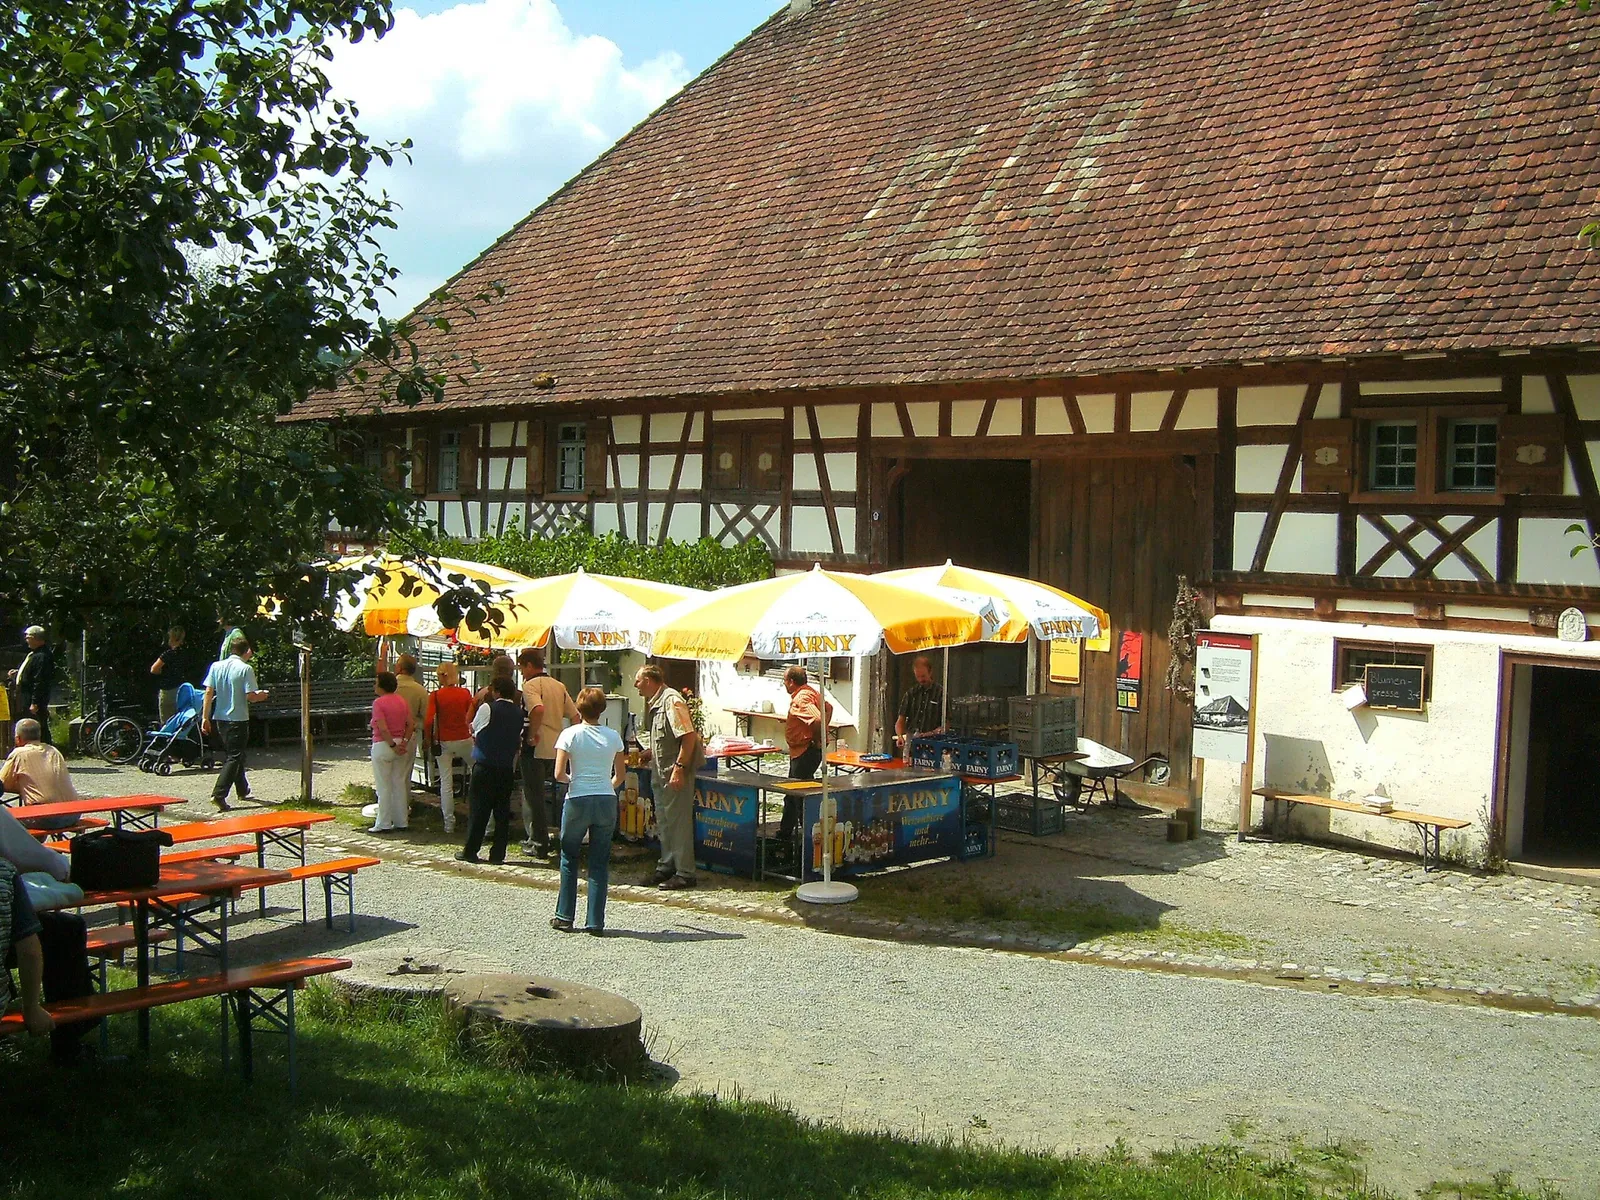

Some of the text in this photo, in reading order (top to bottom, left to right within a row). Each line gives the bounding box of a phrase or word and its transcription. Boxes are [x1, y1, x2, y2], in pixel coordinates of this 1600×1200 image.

[1041, 619, 1083, 635] FARNY
[576, 629, 630, 647] FARN
[777, 634, 857, 654] FARNY
[1201, 640, 1210, 649] 17
[1369, 671, 1413, 686] Blumen-
[914, 758, 936, 768] FARNY
[966, 764, 989, 774] FARNY
[996, 763, 1014, 773] FARNY
[693, 788, 748, 816] ARNY
[886, 787, 954, 814] FARNY
[901, 813, 944, 826] Weizenbiere
[708, 828, 723, 838] und
[914, 823, 930, 836] und
